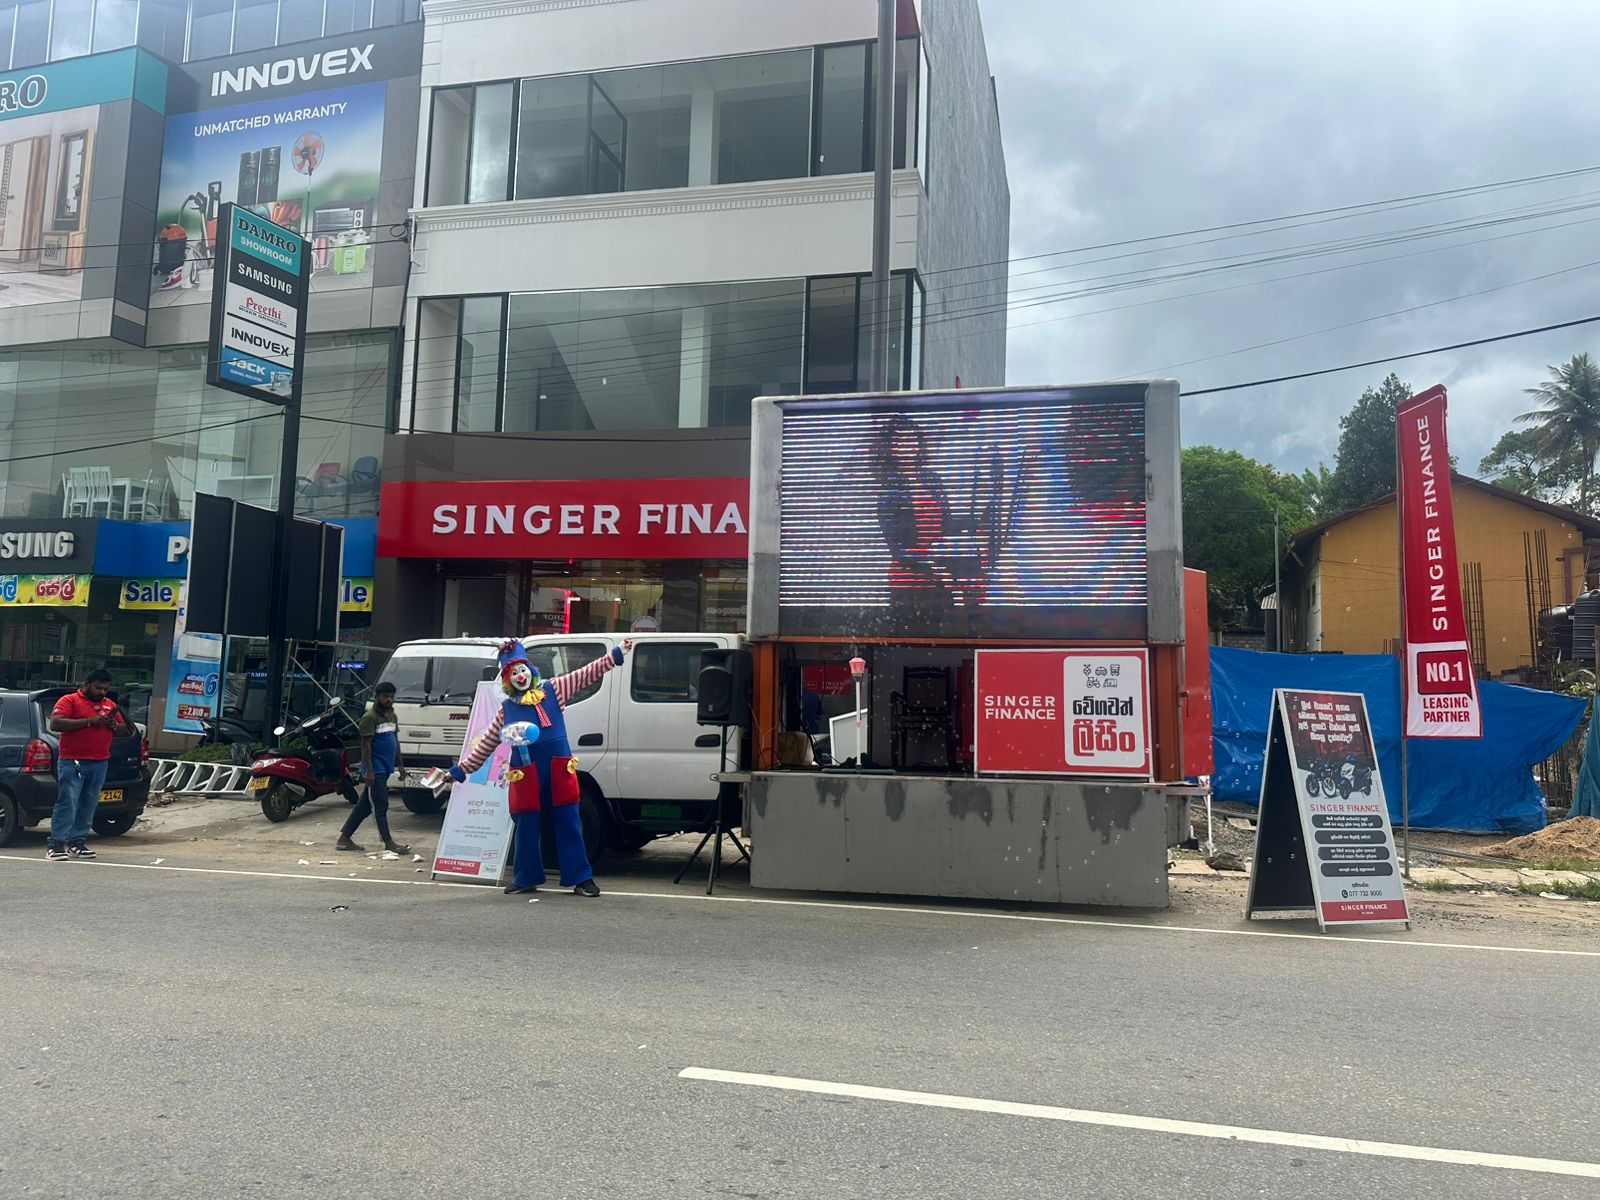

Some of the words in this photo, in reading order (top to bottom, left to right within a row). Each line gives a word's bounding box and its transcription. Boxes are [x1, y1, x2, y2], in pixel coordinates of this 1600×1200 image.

[211, 44, 376, 97] INNOVEX
[194, 116, 271, 137] UNMATCHED
[273, 102, 348, 125] WARRANTY
[238, 217, 297, 253] DAMRO
[240, 236, 293, 266] SHOWROOM
[238, 263, 292, 295] SAMSUNG
[246, 297, 281, 320] Preethi
[231, 327, 289, 357] INNOVEX
[1417, 415, 1438, 519] FINANCE
[432, 504, 620, 535] SINGER
[638, 502, 747, 535] FINA
[0, 531, 74, 558] SUNG
[125, 580, 173, 603] Sale
[1427, 527, 1448, 630] SINGER
[1425, 661, 1465, 683] NO.1
[984, 695, 1056, 707] SINGER
[985, 708, 1056, 720] FINANCE
[1072, 696, 1133, 716] වේගවත්
[1422, 697, 1468, 709] LEASING
[1423, 710, 1470, 724] PARTNER
[1072, 719, 1136, 756] ලීසිං
[1310, 804, 1344, 812] SINGER
[1347, 804, 1380, 812] FINANCE
[1365, 903, 1388, 911] FINANCE
